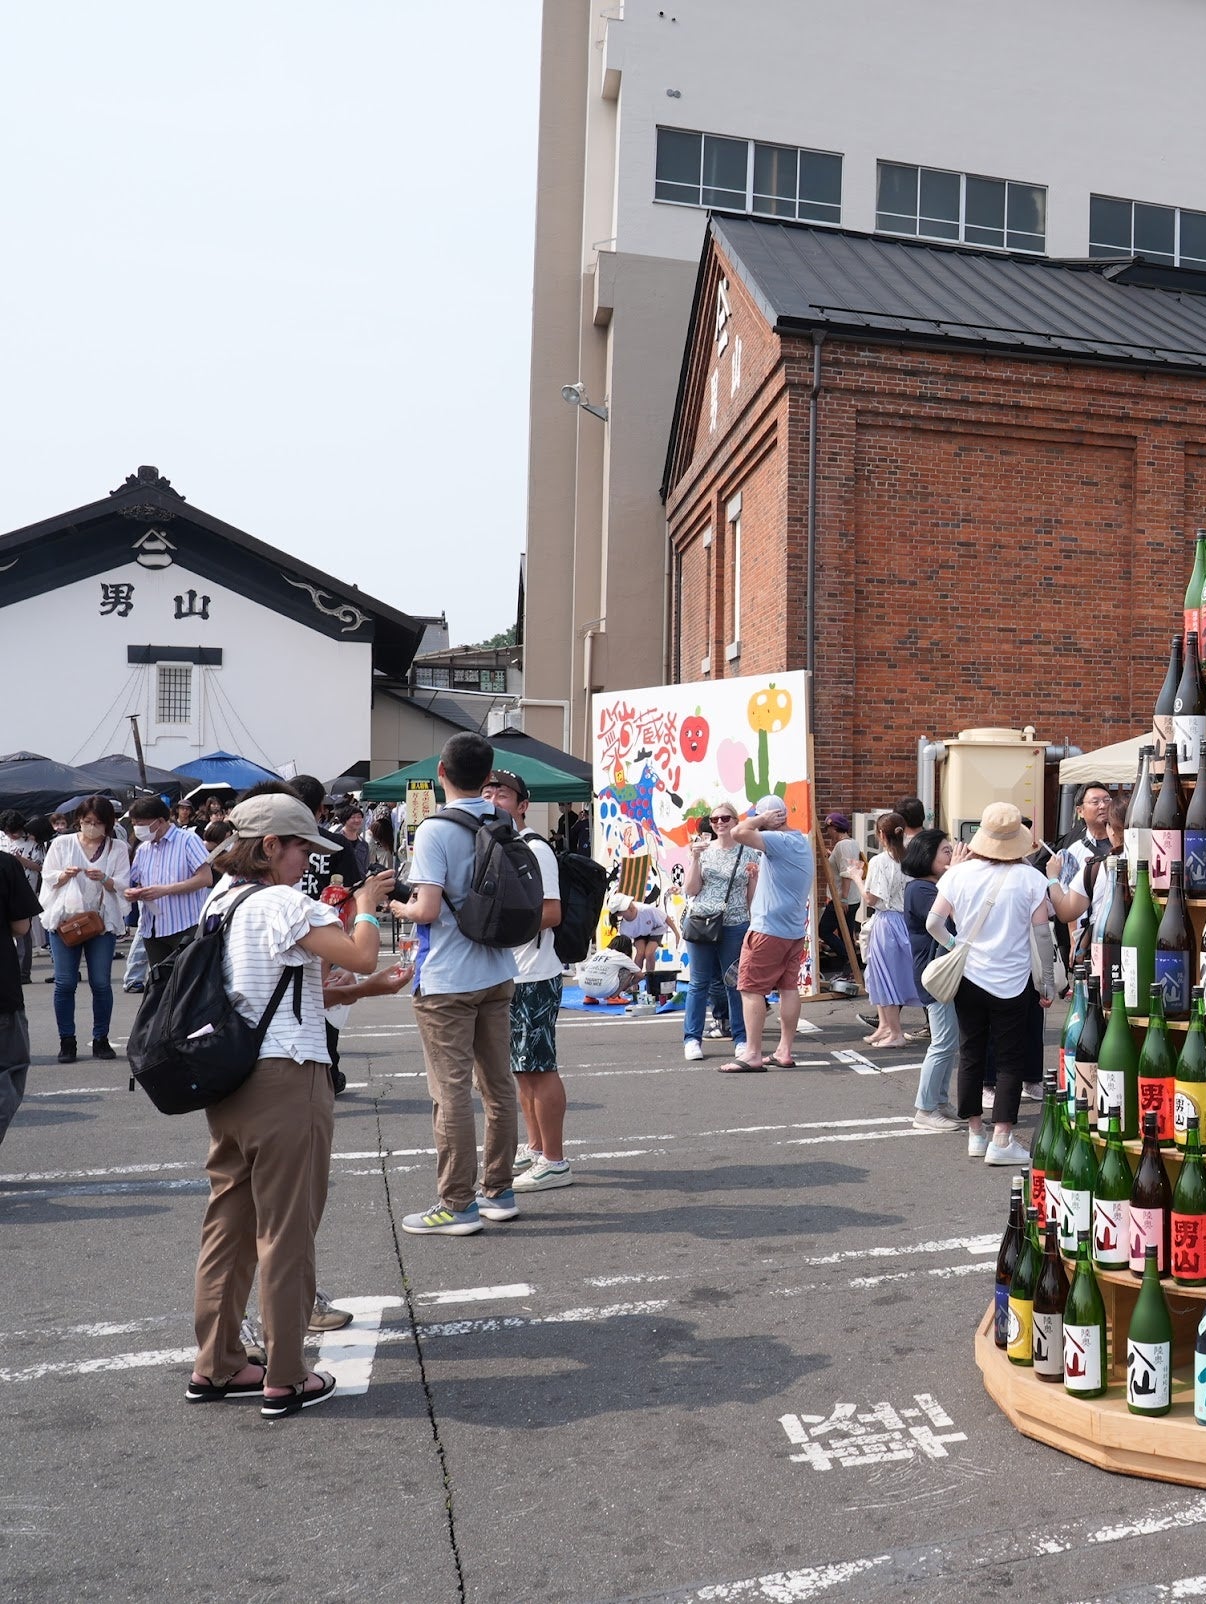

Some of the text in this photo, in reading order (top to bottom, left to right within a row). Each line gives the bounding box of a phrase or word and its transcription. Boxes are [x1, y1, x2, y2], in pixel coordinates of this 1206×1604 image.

[100, 582, 211, 620] 男山
[1185, 851, 1206, 886] 八仙
[1106, 1073, 1116, 1091] 陸奥
[1112, 1203, 1123, 1222] 陸奥
[1142, 1210, 1153, 1230] 陸奥
[1093, 1202, 1118, 1259] 八仙
[1174, 1220, 1199, 1274] 男山
[1043, 1316, 1054, 1335] 陸奥
[1080, 1328, 1092, 1347] 陸奥
[1063, 1327, 1086, 1385] 八仙
[1153, 1345, 1164, 1365] 陸奥
[1127, 1345, 1158, 1403] 八仙
